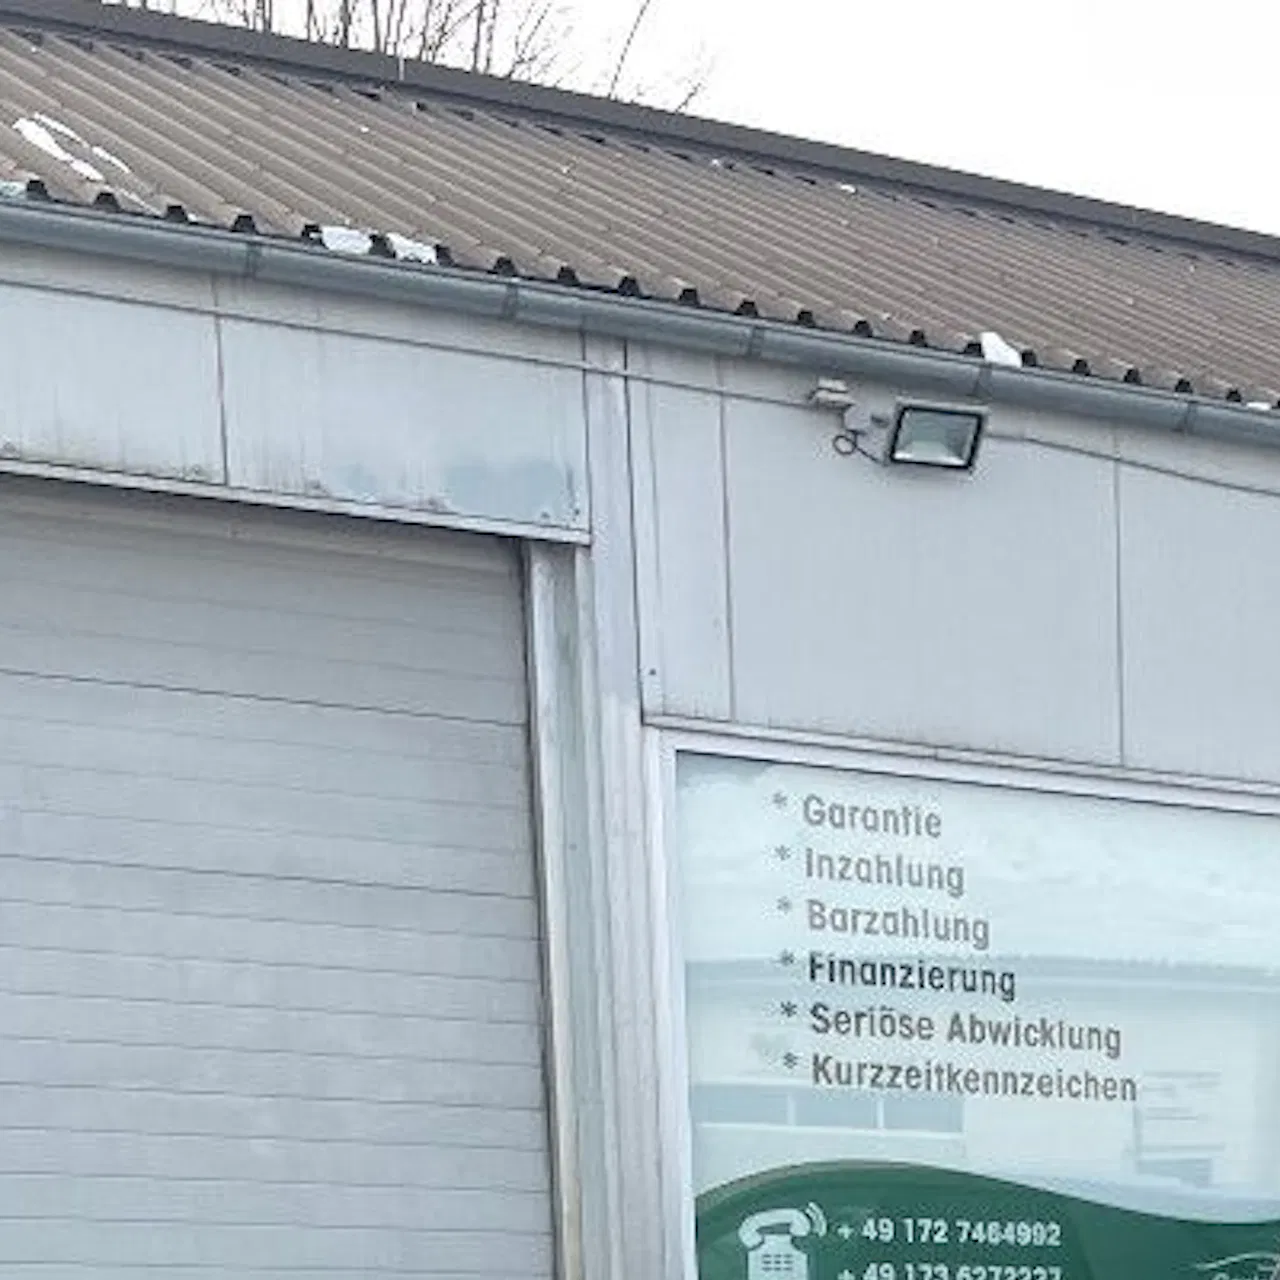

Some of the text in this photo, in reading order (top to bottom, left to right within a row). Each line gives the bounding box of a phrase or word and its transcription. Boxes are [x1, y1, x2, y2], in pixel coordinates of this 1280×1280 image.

[802, 794, 942, 839] Garantie
[804, 848, 965, 897] Inzahlung
[807, 899, 990, 951] Barzahlung
[809, 951, 1017, 1001] Finanzierung
[810, 1001, 1122, 1058] Seriöse Abwicklung
[812, 1052, 1138, 1102] Kurzzeitkennzeichen
[861, 1217, 895, 1243] 49
[904, 1218, 949, 1243] 172
